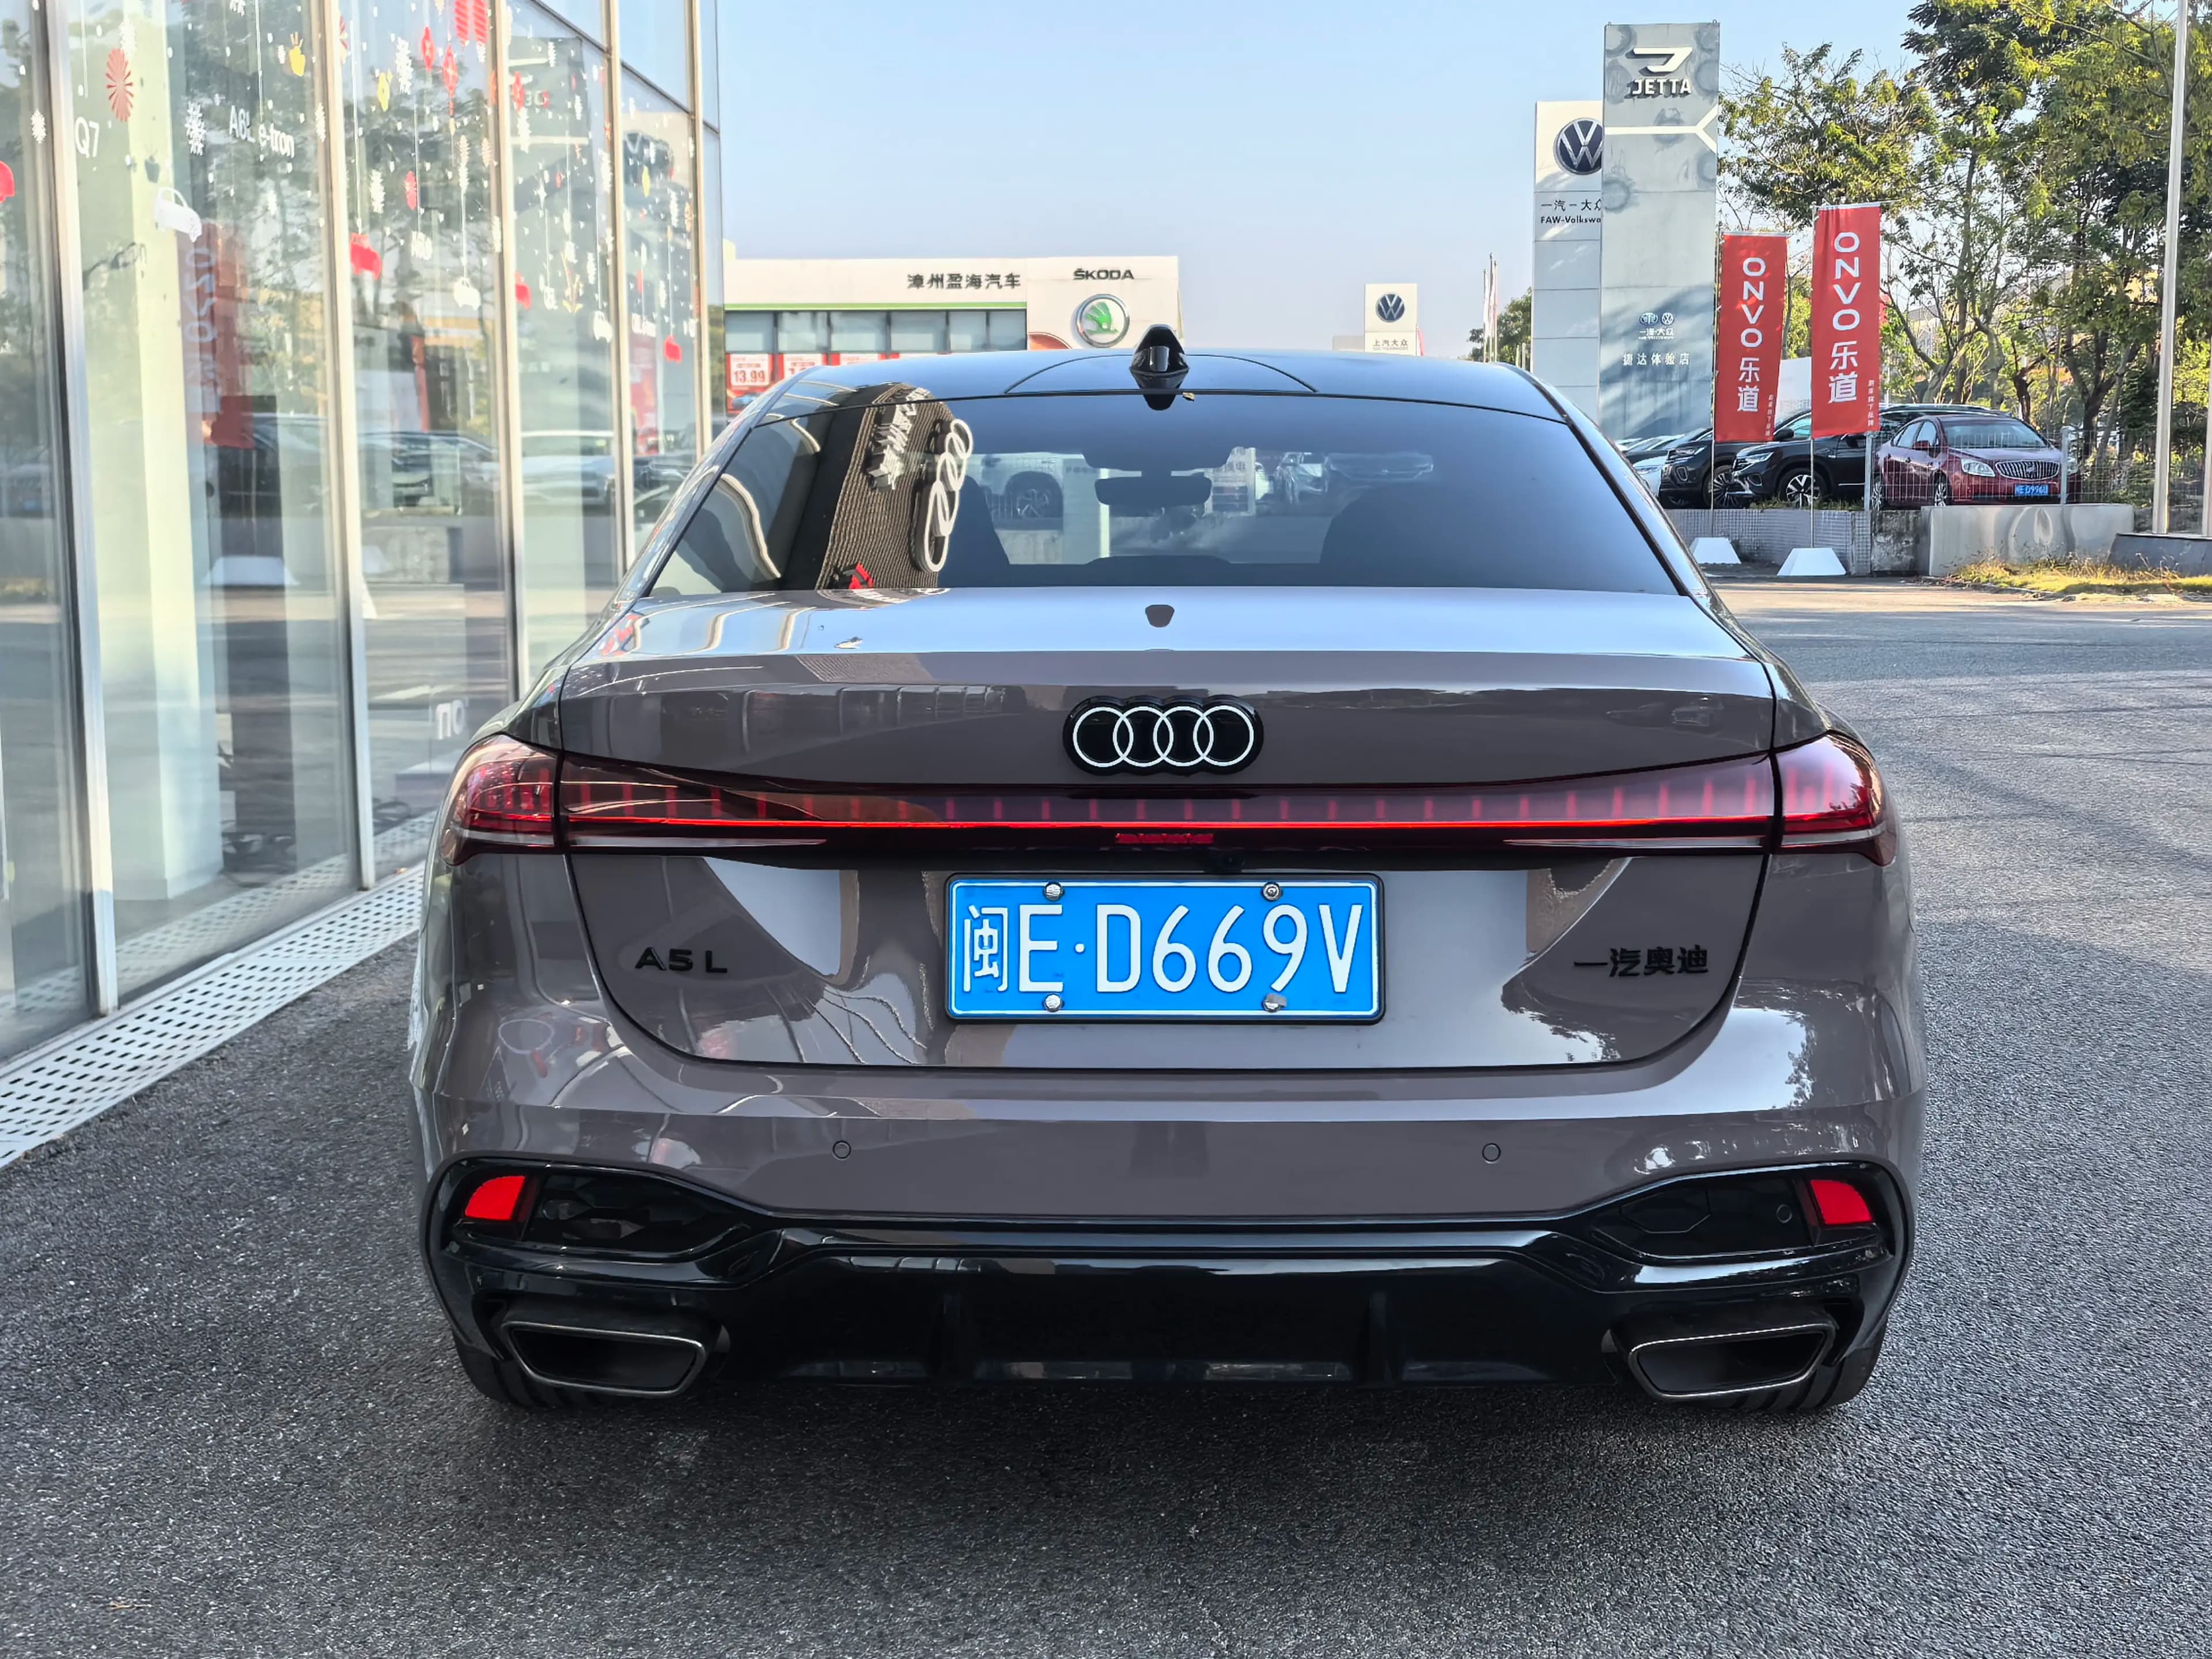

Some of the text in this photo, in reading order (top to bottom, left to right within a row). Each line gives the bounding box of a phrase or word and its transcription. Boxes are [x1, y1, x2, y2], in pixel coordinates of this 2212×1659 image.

[1632, 78, 1692, 94] JETTA
[75, 117, 100, 159] Q7
[259, 122, 295, 159] e-tron
[907, 273, 1021, 289] 漳州盈海汽车
[1073, 268, 1135, 280] ŠKODA
[1737, 257, 1766, 411] ONVO 乐道
[1828, 232, 1861, 404] ONVO 乐道
[734, 370, 766, 383] 13.99
[964, 904, 1363, 993] 闽E·D669V
[1574, 945, 1709, 978] 一汽奥迪
